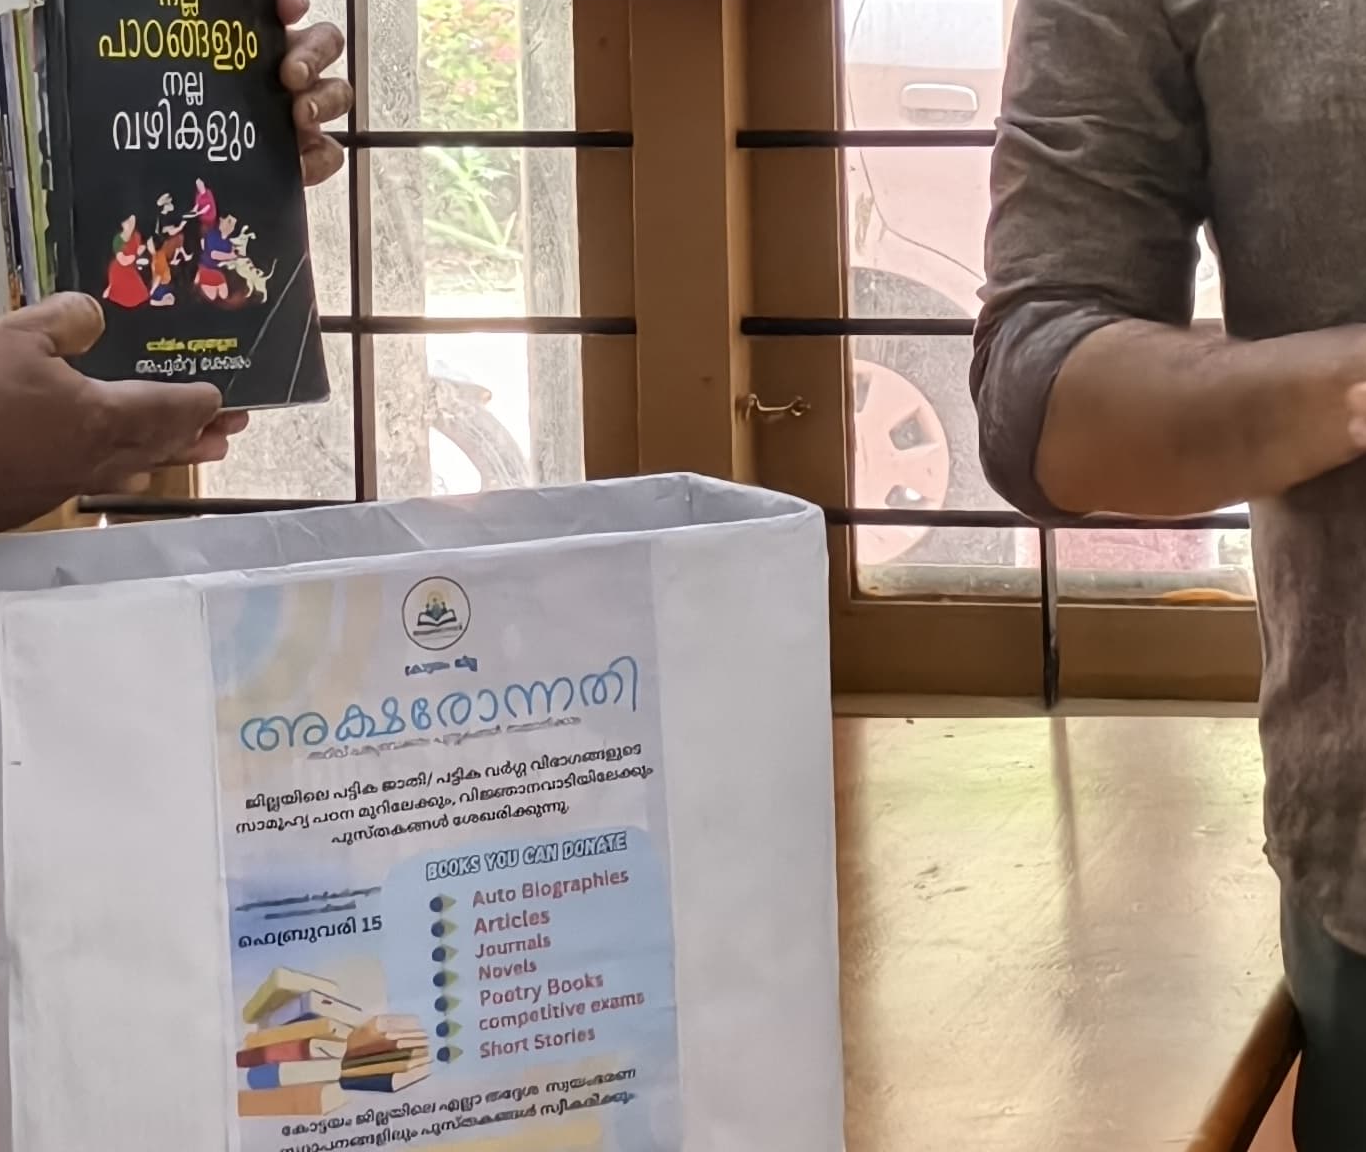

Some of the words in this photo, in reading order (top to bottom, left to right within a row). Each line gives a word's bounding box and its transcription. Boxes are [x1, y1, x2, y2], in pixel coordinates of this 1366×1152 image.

[99, 19, 259, 70] പാഠങ്ങളും
[163, 71, 203, 106] നല്ല
[113, 97, 256, 162] വഴികളും
[240, 656, 638, 752] അക്ഷരോന്നതി
[245, 789, 330, 812] ജില്ലയിലെ
[333, 781, 378, 801] പട്ടിക
[436, 767, 482, 786] പട്ടിക
[485, 760, 527, 778] വർഗ്ഗ
[530, 743, 642, 770] വിഭാഗങ്ങളുടെ
[235, 814, 309, 834] സാമൂഹ്യ
[313, 809, 355, 824] പഠന
[332, 813, 449, 845] പുസ്തകങ്ങൾ
[426, 854, 481, 881] BOOKS
[485, 849, 519, 871] YOU
[523, 842, 559, 865] CAN
[563, 831, 628, 861] DONATE
[473, 889, 516, 908] Auto
[522, 869, 630, 899] Biographies
[238, 916, 356, 948] ഫെബ്രുവരി
[362, 915, 382, 933] 15
[474, 909, 550, 936] Articles
[475, 933, 551, 959] Journals
[478, 958, 537, 981] Novels
[480, 984, 542, 1007] Poetry
[547, 973, 604, 996] Books
[479, 1001, 586, 1032] competitive
[591, 992, 645, 1013] exams
[480, 1037, 529, 1059] Short
[534, 1027, 595, 1050] Stories
[282, 1118, 352, 1137] കോട്ടയം
[439, 1094, 482, 1112] എല്ലാ
[421, 1105, 536, 1136] പുസ്തകങ്ങൾ
